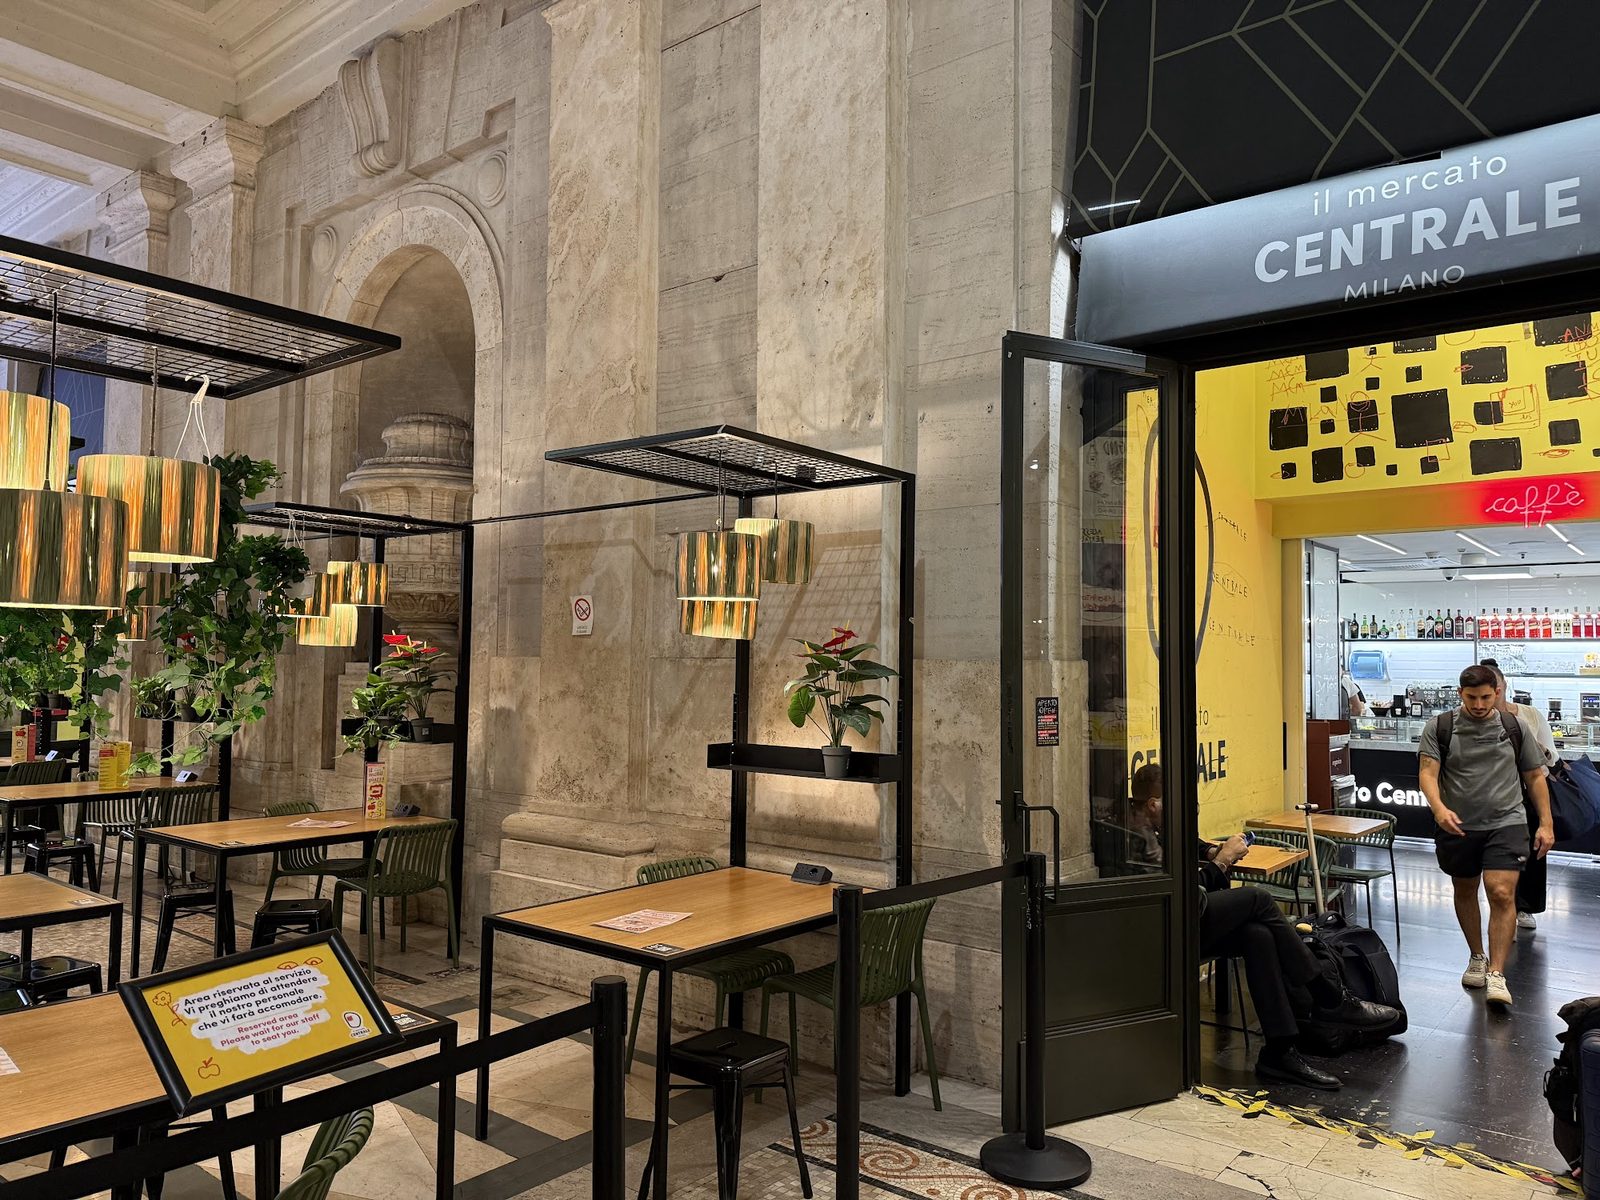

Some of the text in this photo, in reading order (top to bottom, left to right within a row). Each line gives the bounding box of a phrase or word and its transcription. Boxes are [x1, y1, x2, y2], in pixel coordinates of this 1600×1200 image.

[1313, 155, 1507, 215] il mercato
[1254, 176, 1581, 283] CENTRALE
[1344, 264, 1465, 302] MILANO
[1485, 482, 1585, 528] caffè
[184, 968, 312, 1007] Area riservata al servizio
[184, 975, 318, 1015] Vi preghiamo di attendere
[209, 988, 305, 1019] il nostro personale
[198, 994, 322, 1031] che vi farà accomodare.
[220, 1013, 321, 1047] Please wait for our staff
[237, 1012, 299, 1033] Reserved area
[262, 1034, 281, 1043] seat
[281, 1029, 300, 1039] you.
